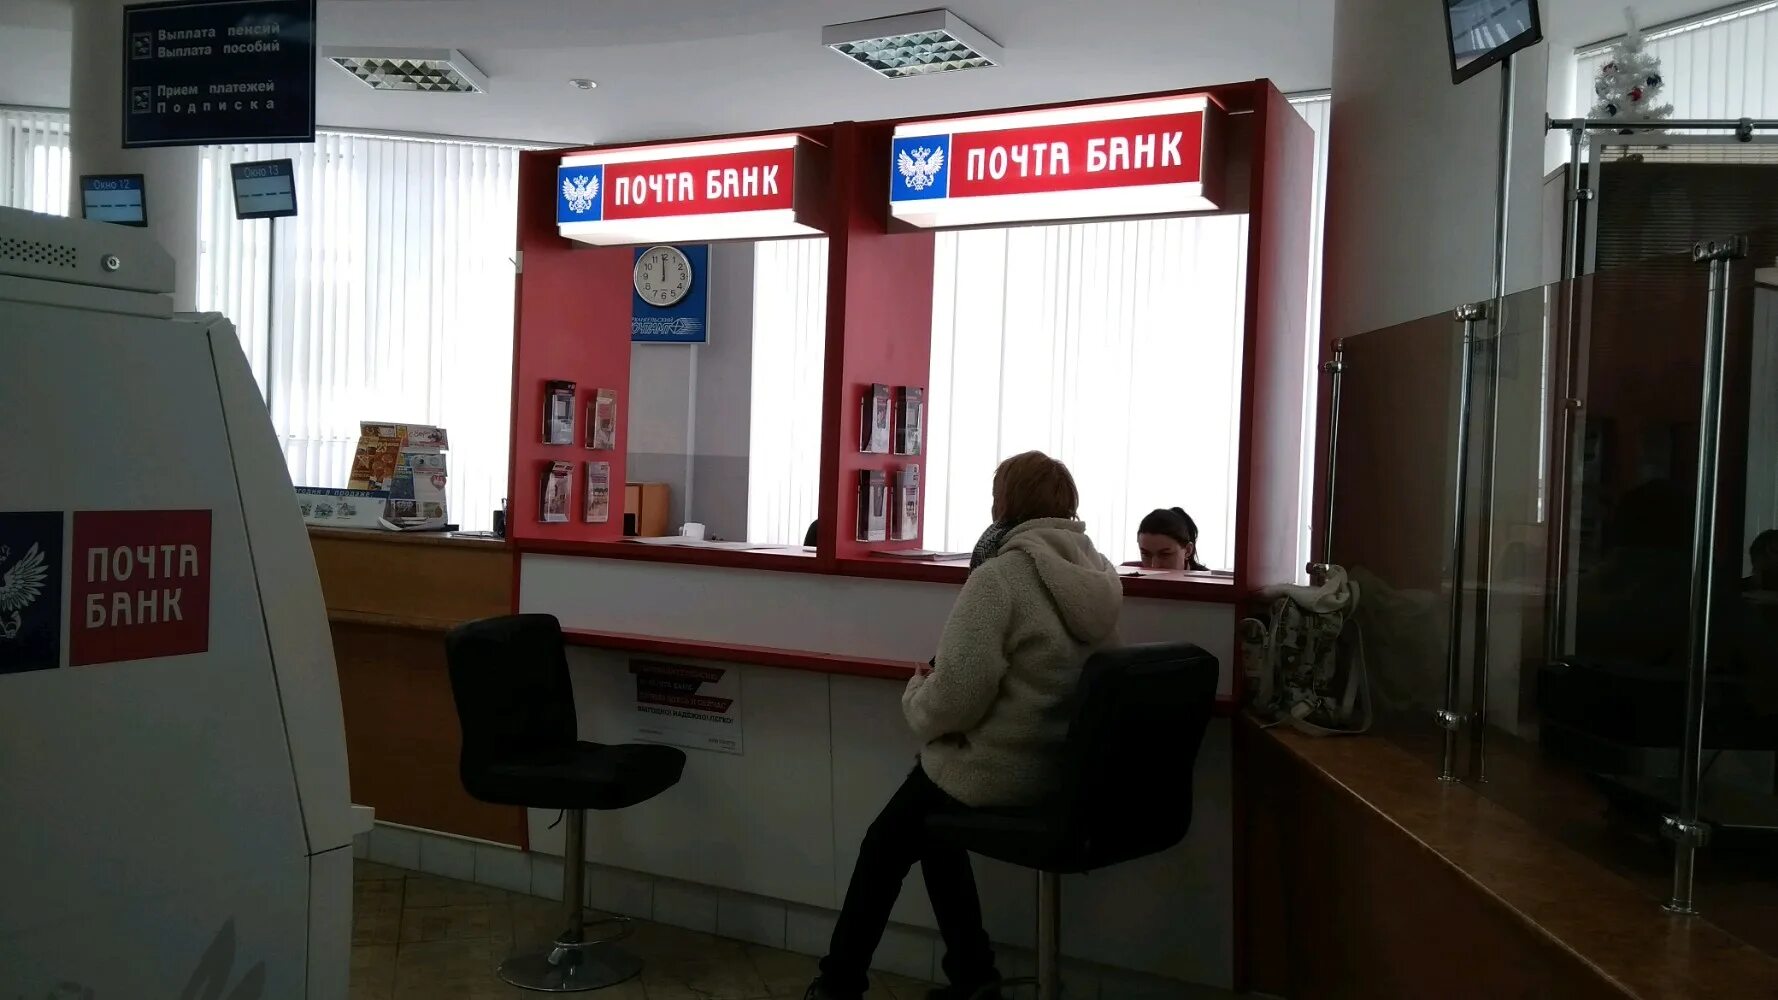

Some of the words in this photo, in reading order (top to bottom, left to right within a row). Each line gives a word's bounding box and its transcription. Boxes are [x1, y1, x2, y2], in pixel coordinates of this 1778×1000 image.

[158, 28, 216, 40] Выплата
[227, 22, 280, 36] пенсий
[158, 46, 212, 58] Выплата
[223, 40, 280, 54] пособий
[157, 85, 198, 99] Прием
[209, 79, 275, 94] платежей
[157, 100, 275, 114] Подписка
[967, 141, 1070, 181] ПОЧТА
[1086, 131, 1183, 172] БАНК
[244, 167, 266, 178] Окно
[268, 165, 279, 176] 13
[93, 180, 116, 190] Окно
[119, 179, 130, 189] 12
[615, 171, 694, 205] ПОЧТА
[706, 165, 779, 199] БАНК
[644, 263, 653, 271] 10
[678, 263, 684, 271] 2
[679, 273, 686, 281] 3
[645, 283, 651, 291] 8
[652, 289, 658, 297] 7
[670, 289, 676, 297] 5
[661, 292, 667, 300] 6
[87, 544, 199, 582] ПОЧТА
[86, 588, 183, 629] БАНК
